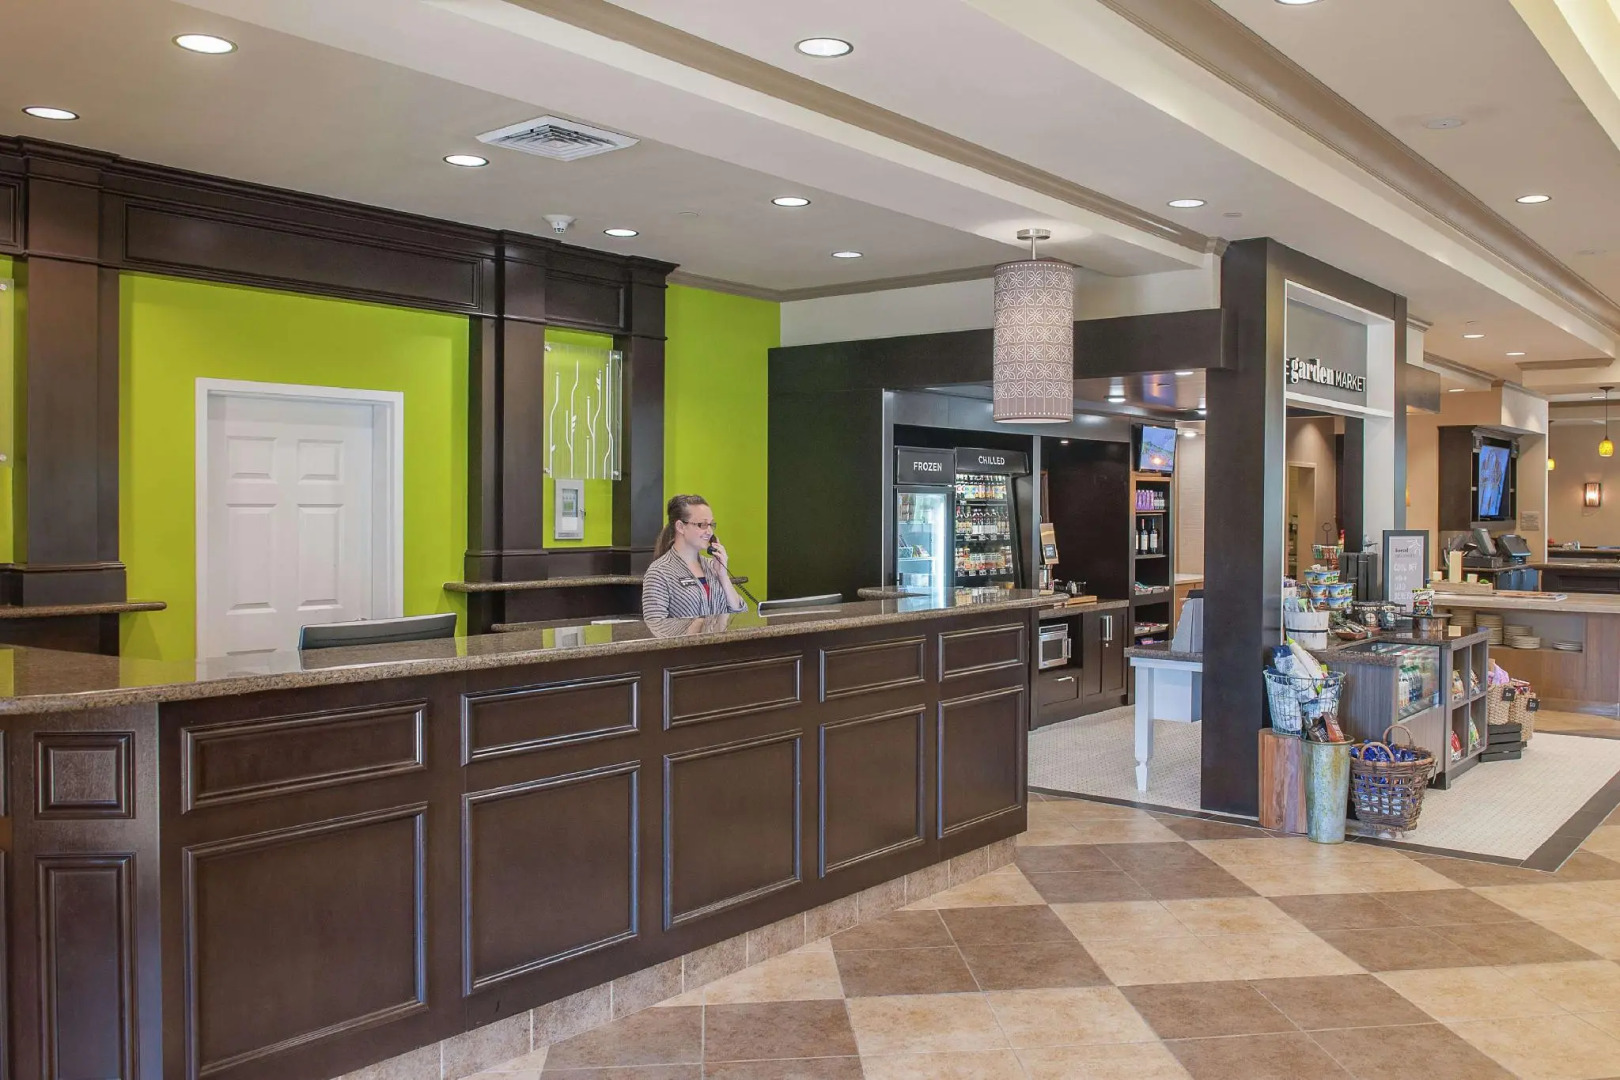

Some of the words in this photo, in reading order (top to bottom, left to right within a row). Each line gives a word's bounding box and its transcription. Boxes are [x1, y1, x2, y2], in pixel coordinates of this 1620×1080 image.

[1291, 357, 1334, 384] garden
[1335, 370, 1366, 392] MARKET
[978, 455, 1006, 466] CHILLED
[913, 461, 943, 472] FROZEN
